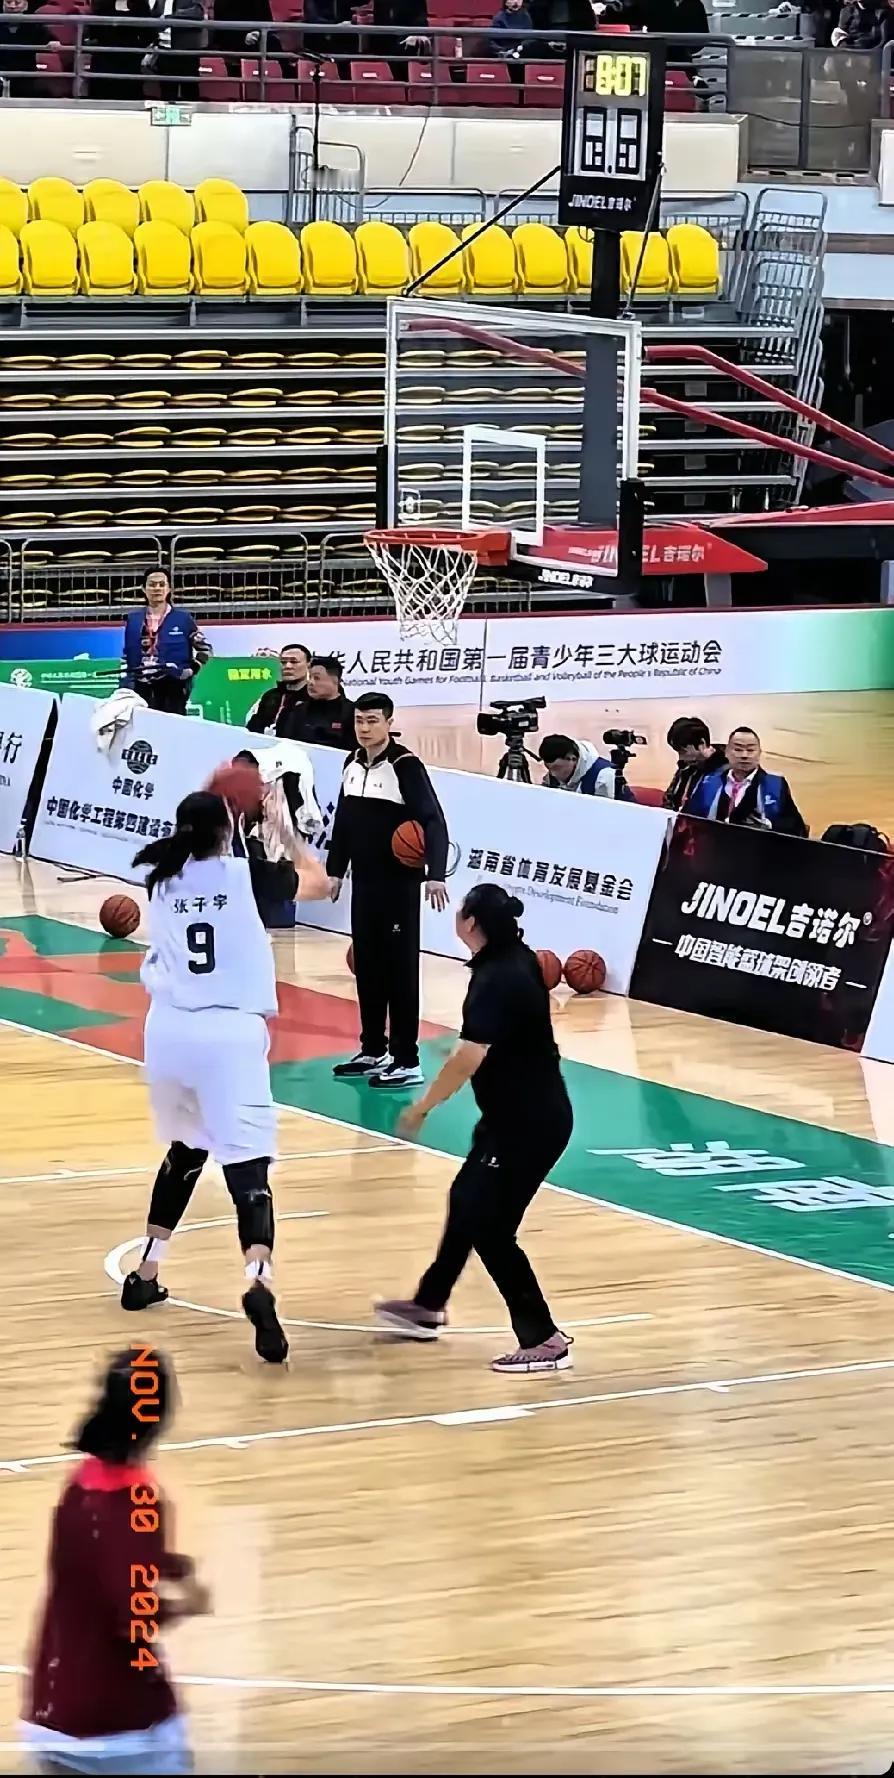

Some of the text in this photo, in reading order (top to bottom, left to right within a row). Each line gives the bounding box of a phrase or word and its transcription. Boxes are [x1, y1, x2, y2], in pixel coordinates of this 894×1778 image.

[0, 732, 23, 763] 行
[46, 796, 178, 838] 中国化学工程第四建设有
[186, 922, 216, 975] 9
